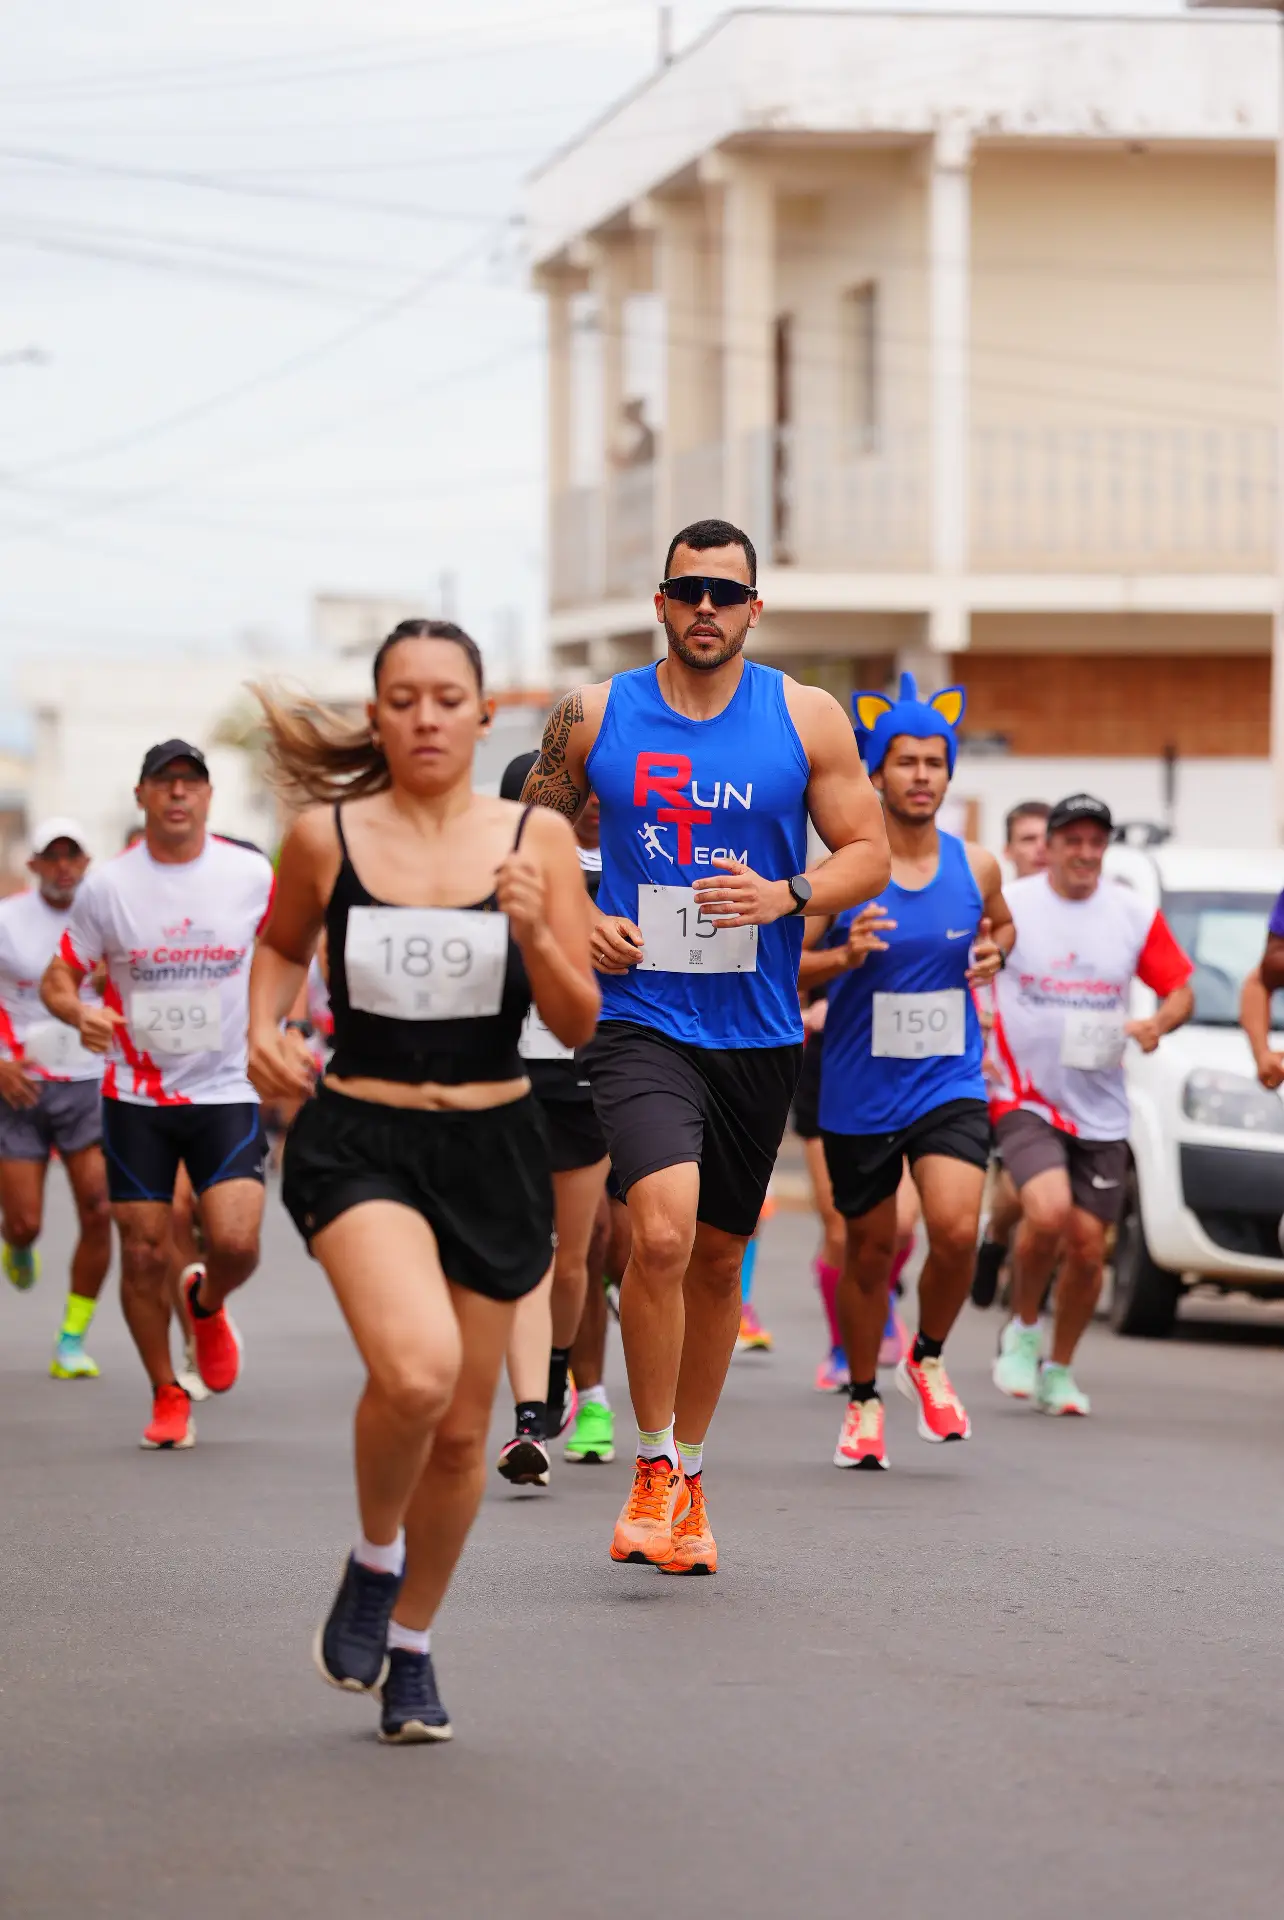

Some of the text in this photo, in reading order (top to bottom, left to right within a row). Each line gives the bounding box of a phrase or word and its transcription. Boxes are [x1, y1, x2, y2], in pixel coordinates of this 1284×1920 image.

[634, 751, 753, 810] RUN
[676, 904, 718, 939] 15
[378, 936, 474, 978] 189
[146, 1004, 208, 1032] 299
[892, 1007, 949, 1035] 150
